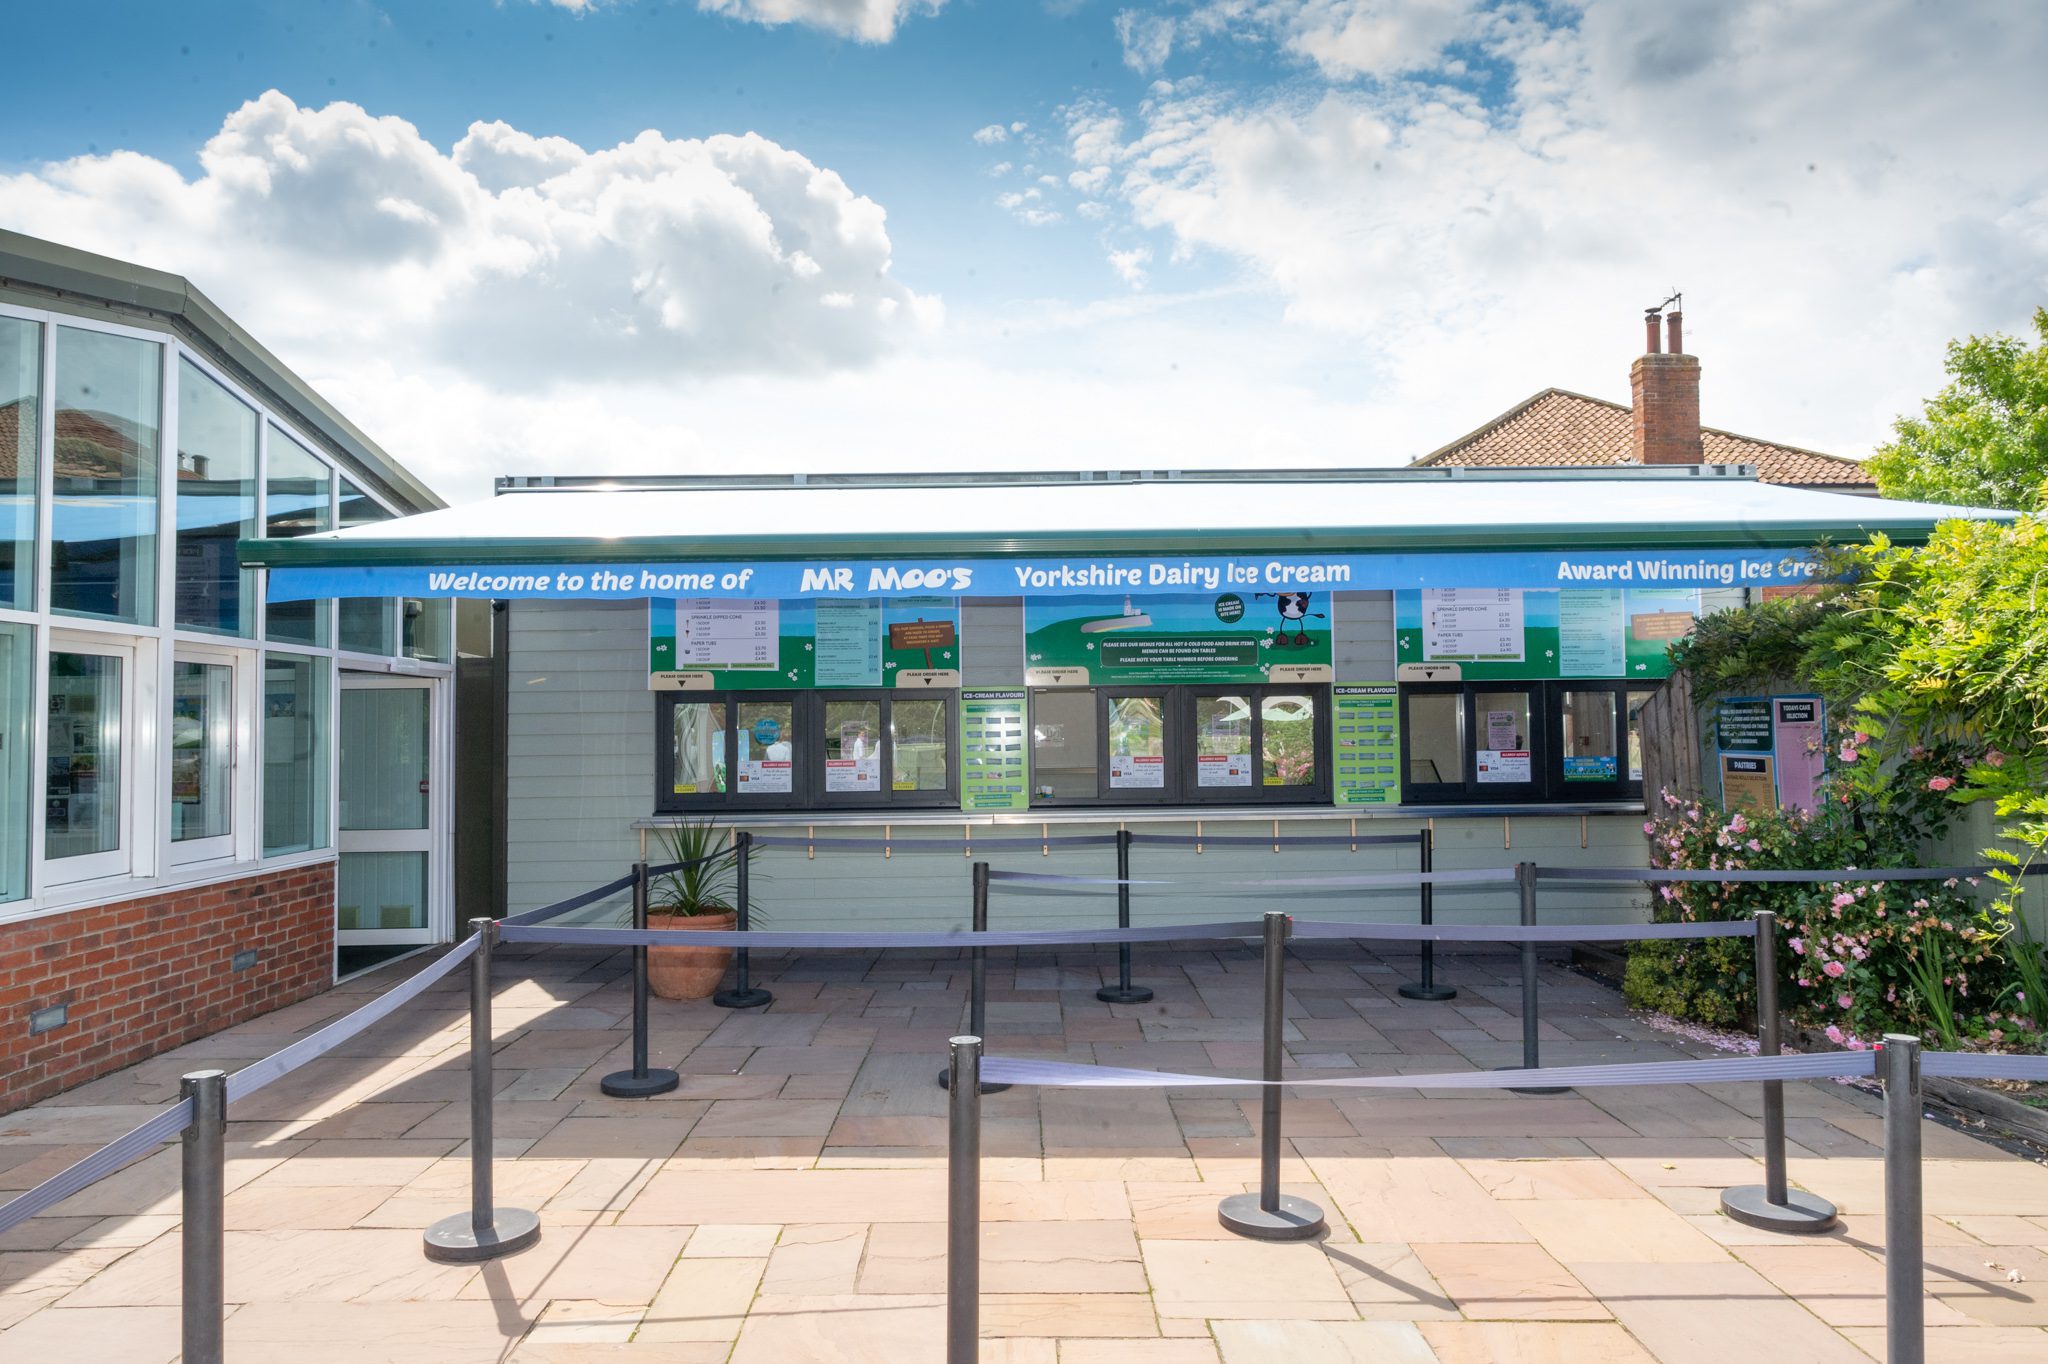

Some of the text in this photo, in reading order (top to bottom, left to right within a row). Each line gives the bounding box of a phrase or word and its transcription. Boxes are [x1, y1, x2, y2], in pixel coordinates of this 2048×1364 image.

[429, 568, 754, 591] Welcome to the home of
[800, 567, 854, 592] MR
[1014, 561, 1351, 589] Yorkshire Dairy Ice Cream
[1557, 560, 1633, 580] Award
[1636, 559, 1734, 584] Winning
[1741, 559, 1772, 579] Ice
[1734, 761, 1757, 770] PASTRIES
